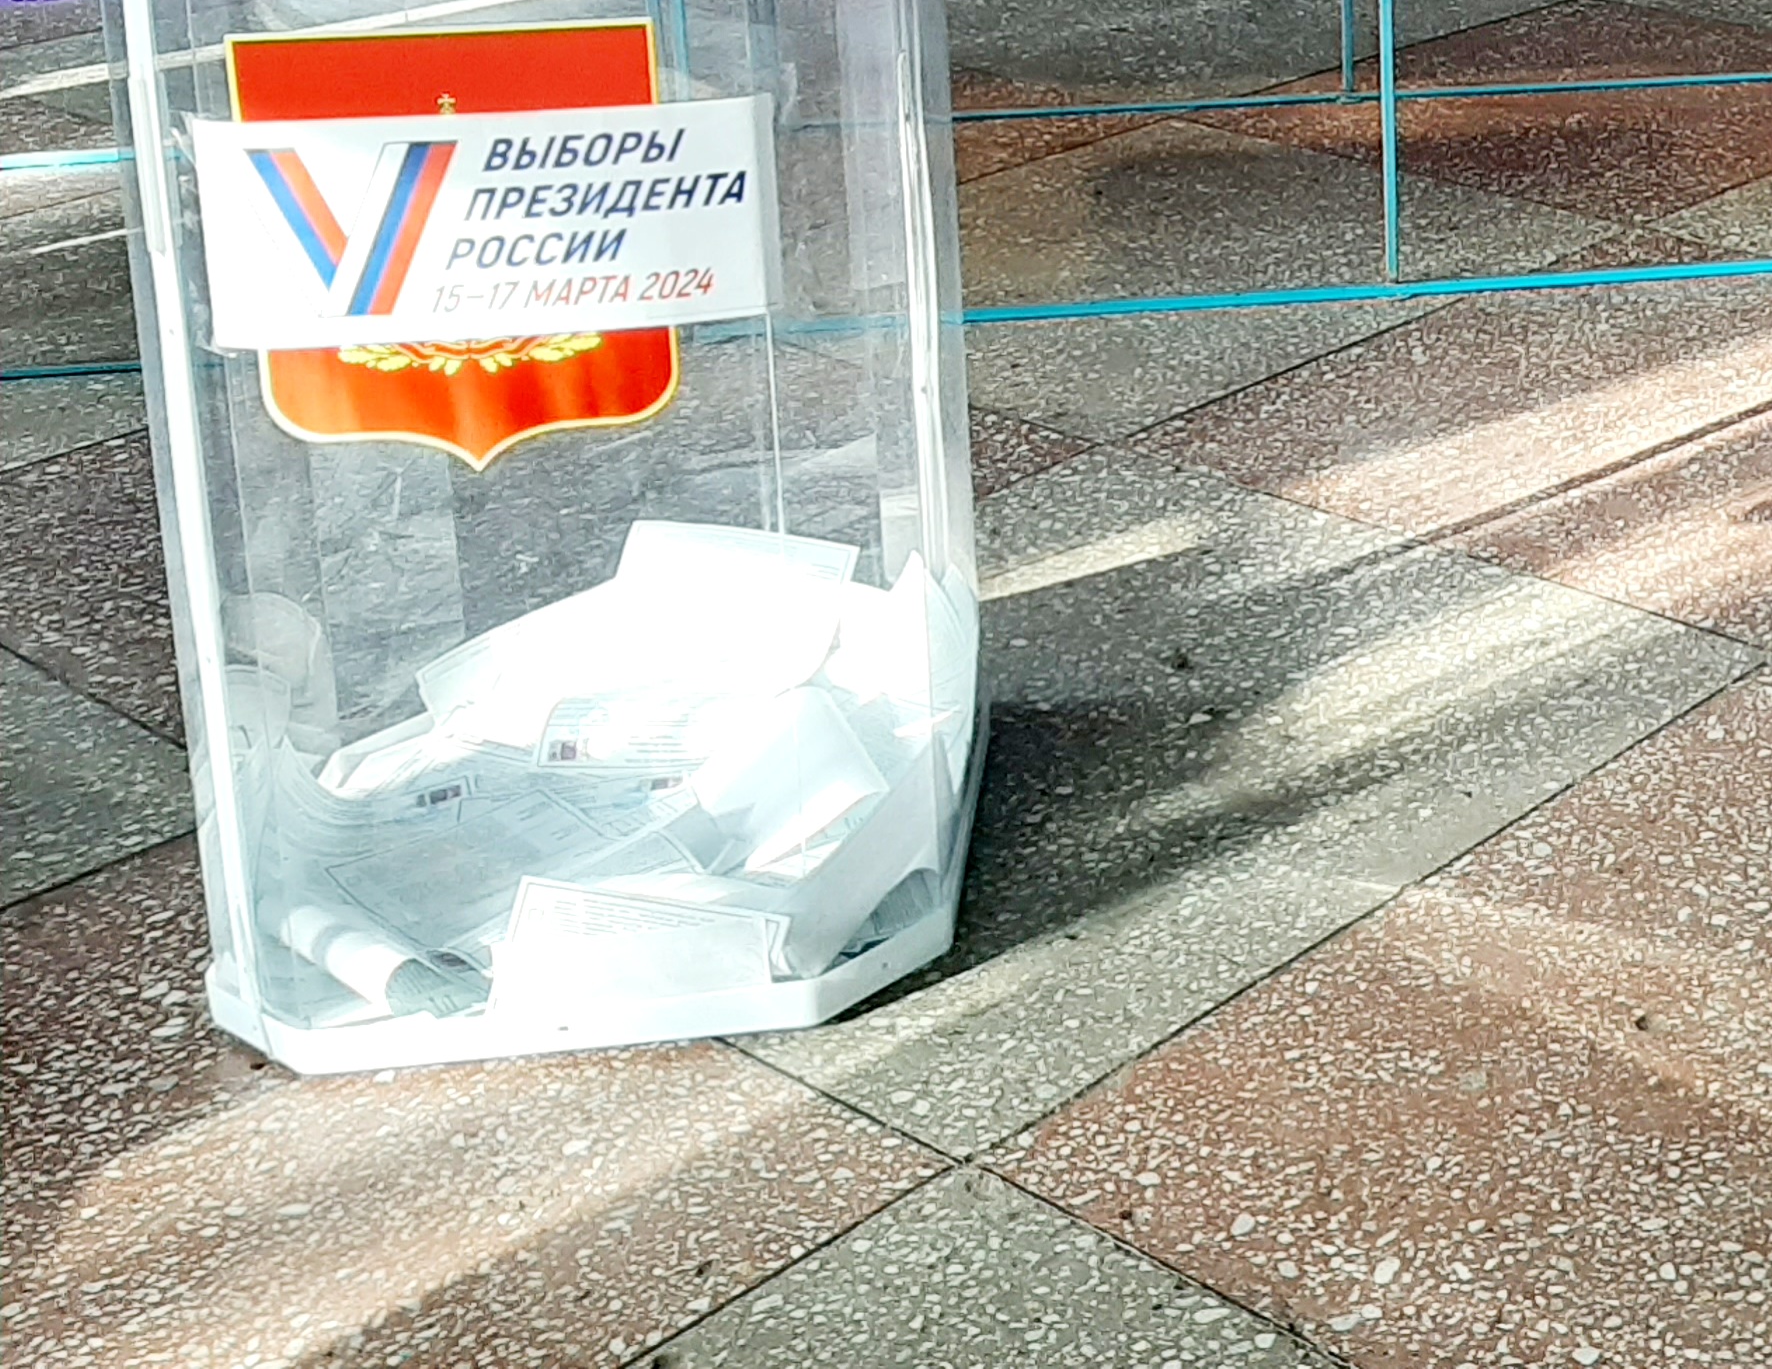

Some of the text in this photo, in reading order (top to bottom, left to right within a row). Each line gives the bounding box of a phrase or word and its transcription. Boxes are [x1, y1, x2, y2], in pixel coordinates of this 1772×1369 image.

[482, 128, 686, 172] ВЫБОРЫ
[464, 171, 747, 221] ПРЕЗИДЕНТА
[445, 228, 628, 271] РОССИИ
[523, 273, 632, 309] МАРТА
[637, 266, 714, 302] 2024
